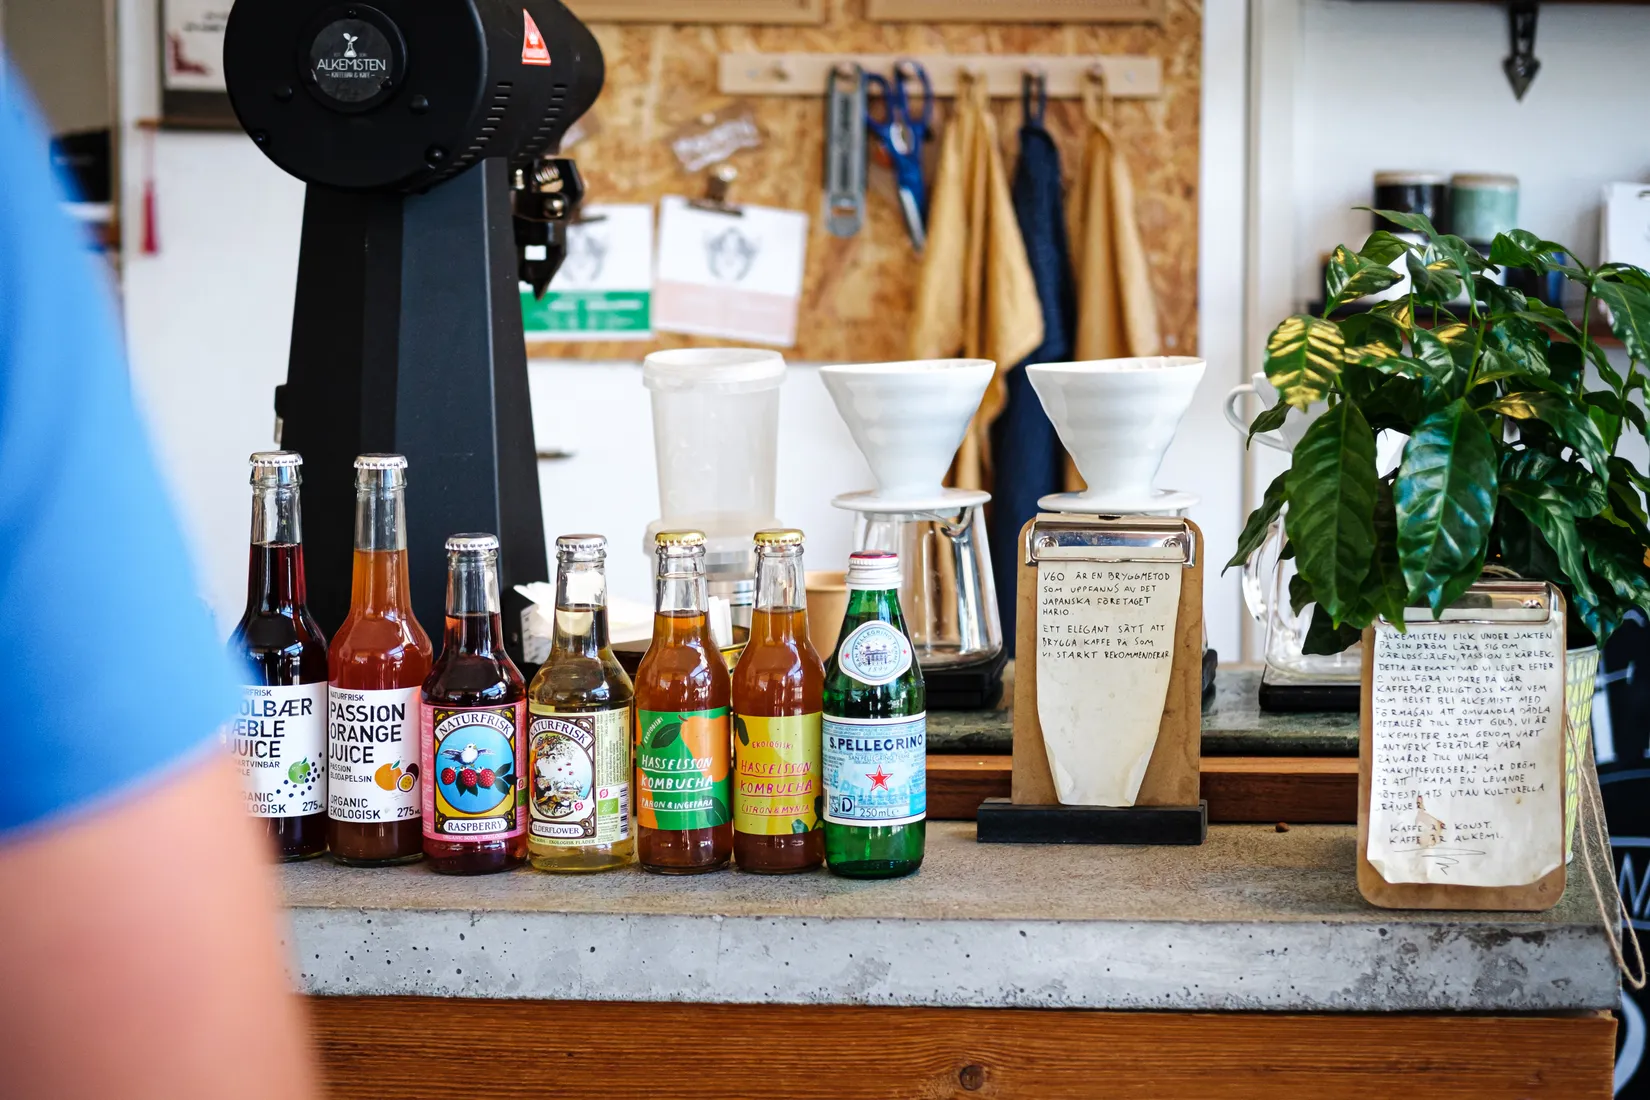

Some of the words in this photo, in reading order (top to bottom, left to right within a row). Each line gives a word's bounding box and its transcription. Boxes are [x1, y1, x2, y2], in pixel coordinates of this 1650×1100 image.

[317, 59, 386, 70] ALKEMISTEN
[1043, 572, 1065, 581] V60
[1091, 572, 1102, 580] EN
[1108, 572, 1170, 581] BRYGGMETOD
[1043, 585, 1062, 593] SOM
[1070, 583, 1119, 593] UPPFANNS
[1124, 585, 1136, 593] AV
[1140, 584, 1157, 592] DET
[1042, 597, 1091, 606] JAPANSKA
[1043, 625, 1060, 633] ETT
[1067, 625, 1109, 634] ELEGANT
[1042, 637, 1077, 646] BRYGGA
[1083, 638, 1110, 646] KAFFE
[1135, 637, 1154, 646] SOM
[1480, 632, 1509, 640] UNDER
[1513, 632, 1552, 640] JAKTEN
[1417, 642, 1446, 650] DRÖM
[1057, 651, 1098, 659] STARKT
[1104, 650, 1169, 659] REKOMMENDERAR
[1461, 652, 1501, 660] PASSION
[1379, 663, 1405, 671] DETTA
[1529, 663, 1554, 671] EFTER
[1446, 675, 1480, 684] VIDARE
[330, 690, 365, 701] NATURFRISK
[1437, 686, 1471, 694] ENLIGT
[1403, 696, 1431, 704] HELST
[1438, 696, 1455, 704] BLI
[1461, 696, 1512, 705] ALKEMIST
[1519, 695, 1541, 704] MED
[238, 697, 313, 718] OLBÆR
[330, 702, 406, 723] PASSION
[439, 713, 512, 737] NATURFRISK
[1456, 718, 1483, 726] RENT
[232, 718, 285, 738] ÆBLE
[330, 722, 402, 743] ORANGE
[530, 718, 589, 745] NATURFRISK
[829, 734, 923, 752] S.PELLEGRINO
[1377, 742, 1431, 751] ANTVERK
[231, 739, 281, 759] JUICE
[330, 742, 374, 764] JUICE
[642, 754, 713, 770] HASSELSSON
[1433, 753, 1450, 761] TILL
[1458, 753, 1488, 762] UNIKA
[330, 762, 351, 773] PASSION
[741, 760, 812, 775] HASSELSSON
[330, 771, 372, 783] BLODAPELSIN
[641, 774, 713, 790] KOMBUCHA
[1418, 777, 1452, 785] SKAPA
[1460, 776, 1475, 784] EN
[1482, 774, 1525, 785] LEVANDE
[740, 779, 813, 795] KOMBUCHA
[1377, 789, 1442, 799] ÖTESPLATS
[1450, 789, 1479, 797] UTAN
[1483, 783, 1544, 796] KULTURELLA
[330, 795, 368, 808] ORGANIC
[330, 805, 381, 820] EKOLOGISK
[741, 803, 772, 814] CITRON
[781, 804, 810, 814] MYNTA
[448, 820, 503, 831] RASPBERRY
[533, 823, 580, 835] ELDERFLOWER
[1390, 822, 1422, 833] KAFFE
[1389, 836, 1420, 845] KAFFE
